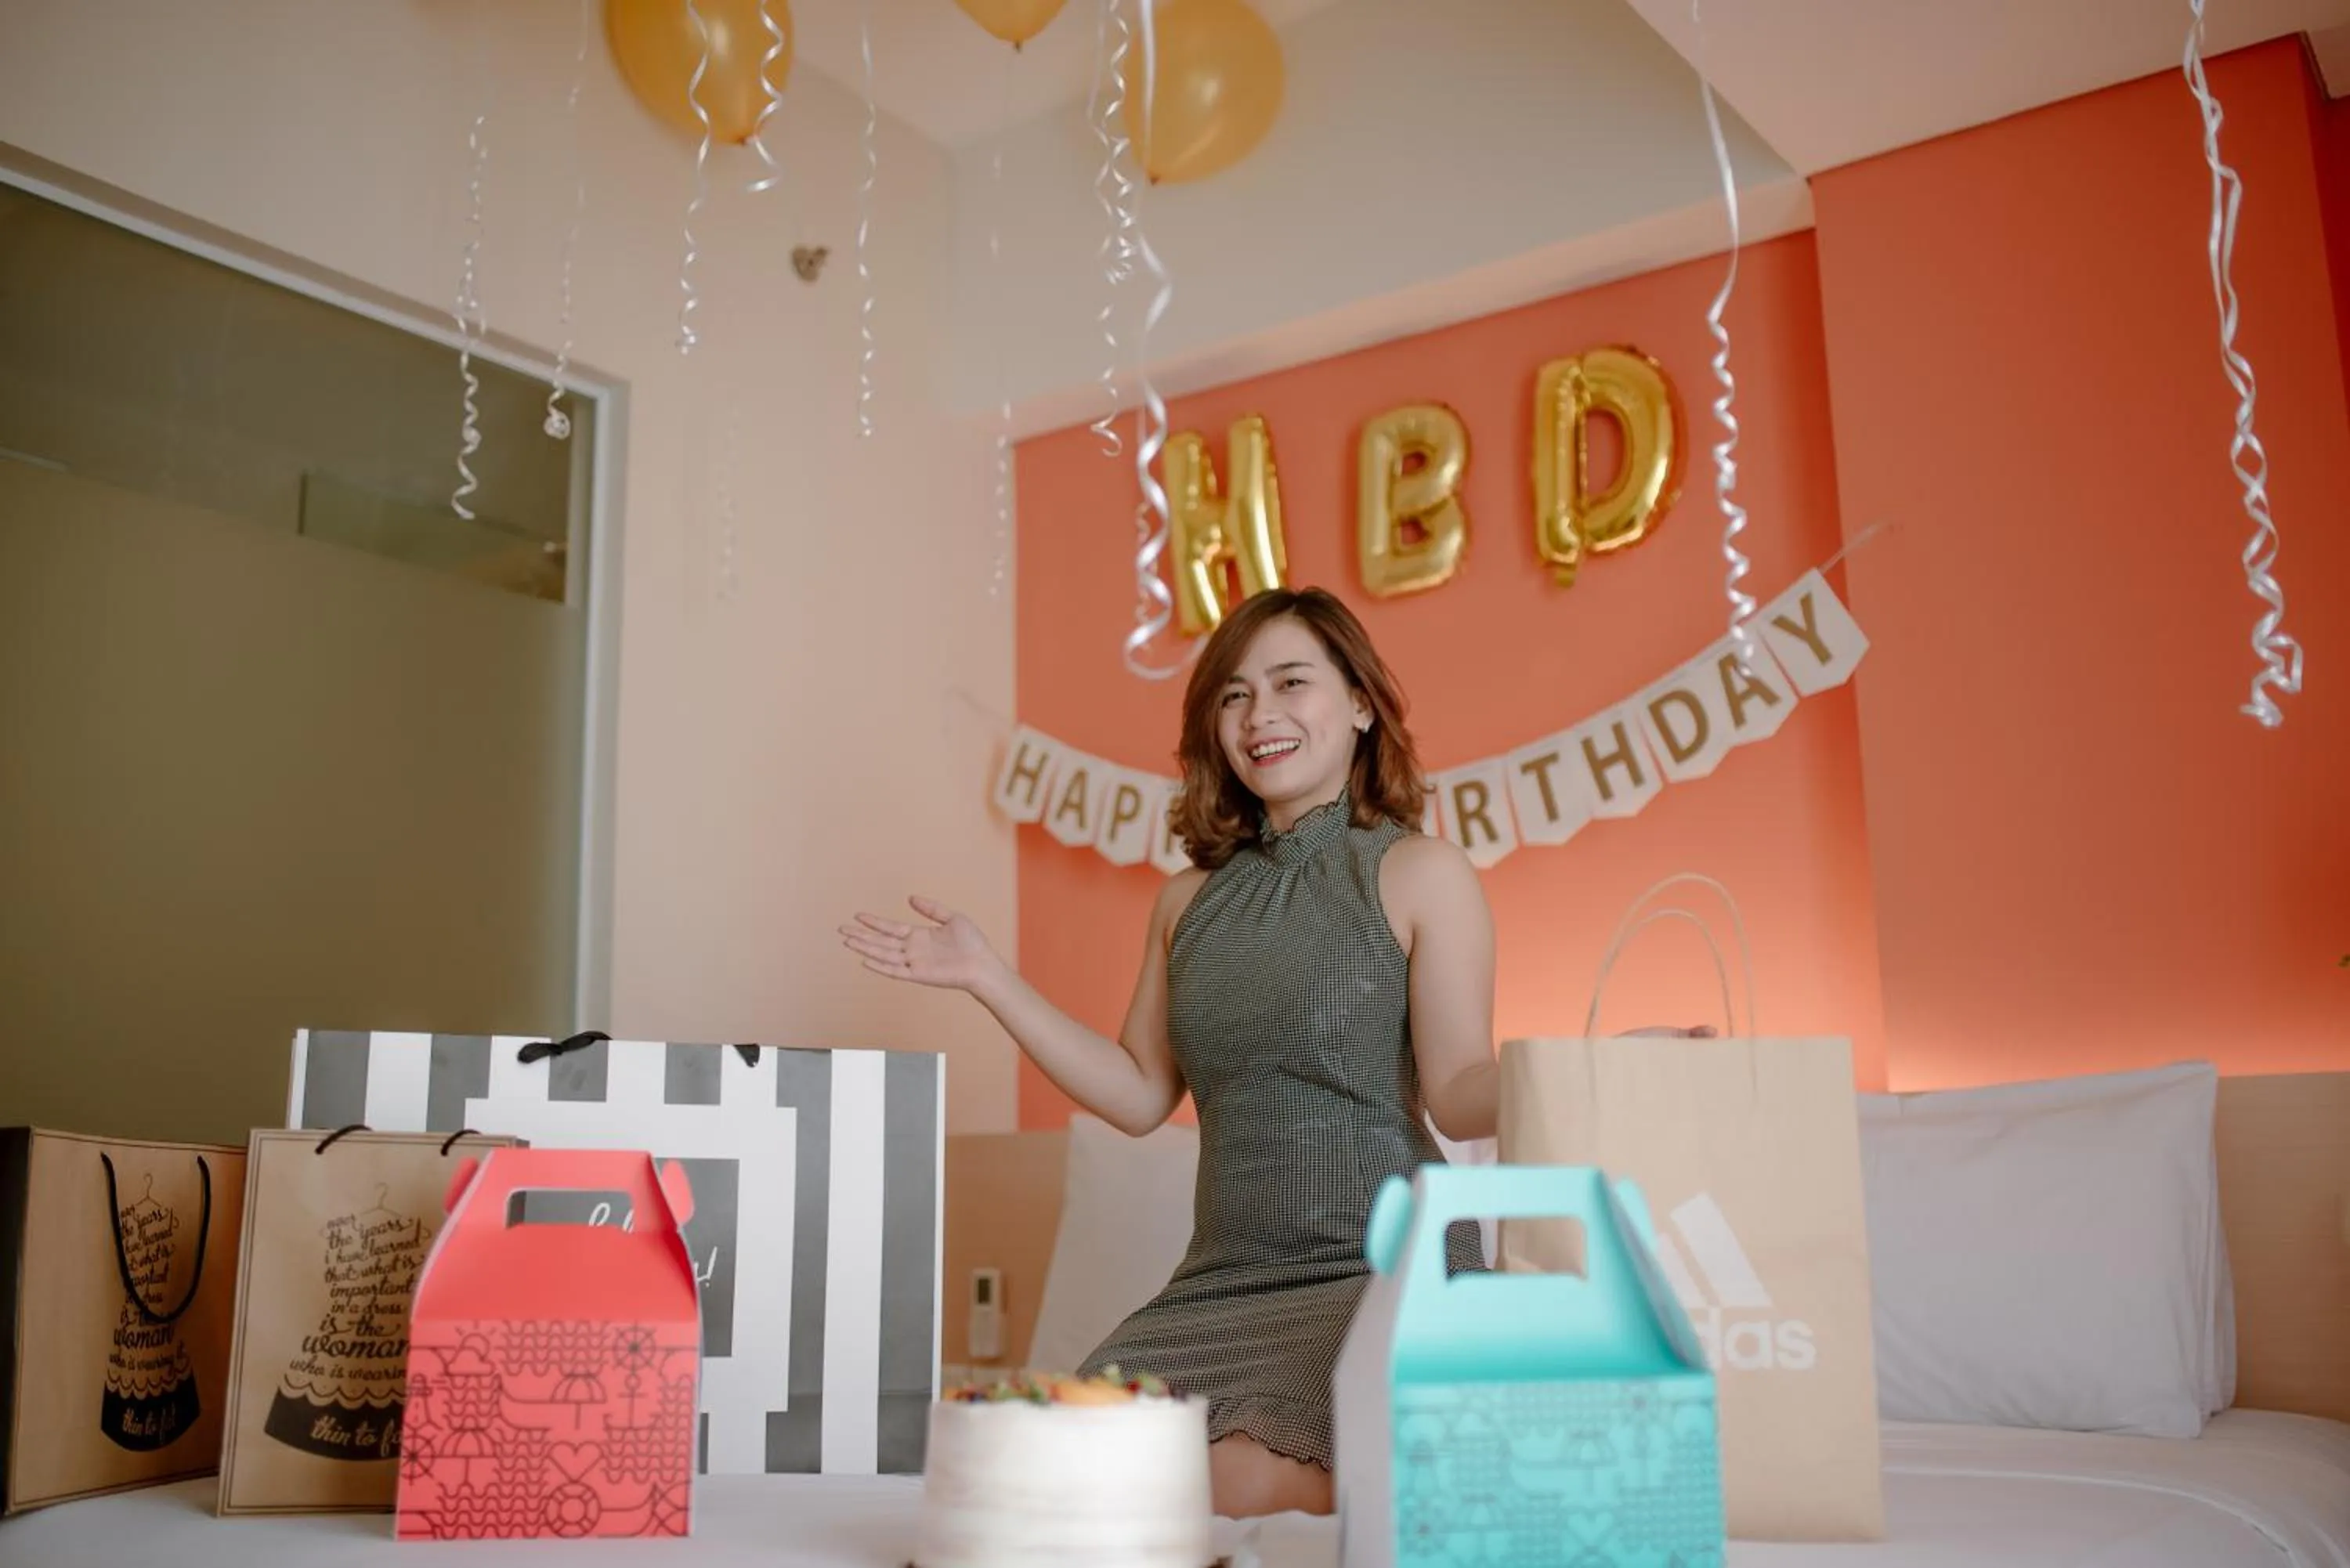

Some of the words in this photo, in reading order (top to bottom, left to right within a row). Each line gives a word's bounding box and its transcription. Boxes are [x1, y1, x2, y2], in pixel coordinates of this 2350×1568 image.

[1006, 742, 1185, 855] HAP
[1452, 590, 1832, 848] RTHDAY
[328, 1227, 353, 1250] the
[359, 1218, 414, 1250] years
[368, 1216, 421, 1256] learned
[324, 1264, 358, 1284] that
[360, 1253, 400, 1278] what
[329, 1273, 415, 1307] important
[330, 1299, 345, 1314] in
[349, 1303, 359, 1314] a
[319, 1313, 351, 1335] is
[348, 1313, 401, 1337] the
[289, 1354, 325, 1376] who
[329, 1364, 345, 1379] is
[347, 1364, 407, 1381] wearin
[309, 1414, 351, 1447] thin
[355, 1420, 378, 1447] to
[379, 1418, 403, 1458] fa
